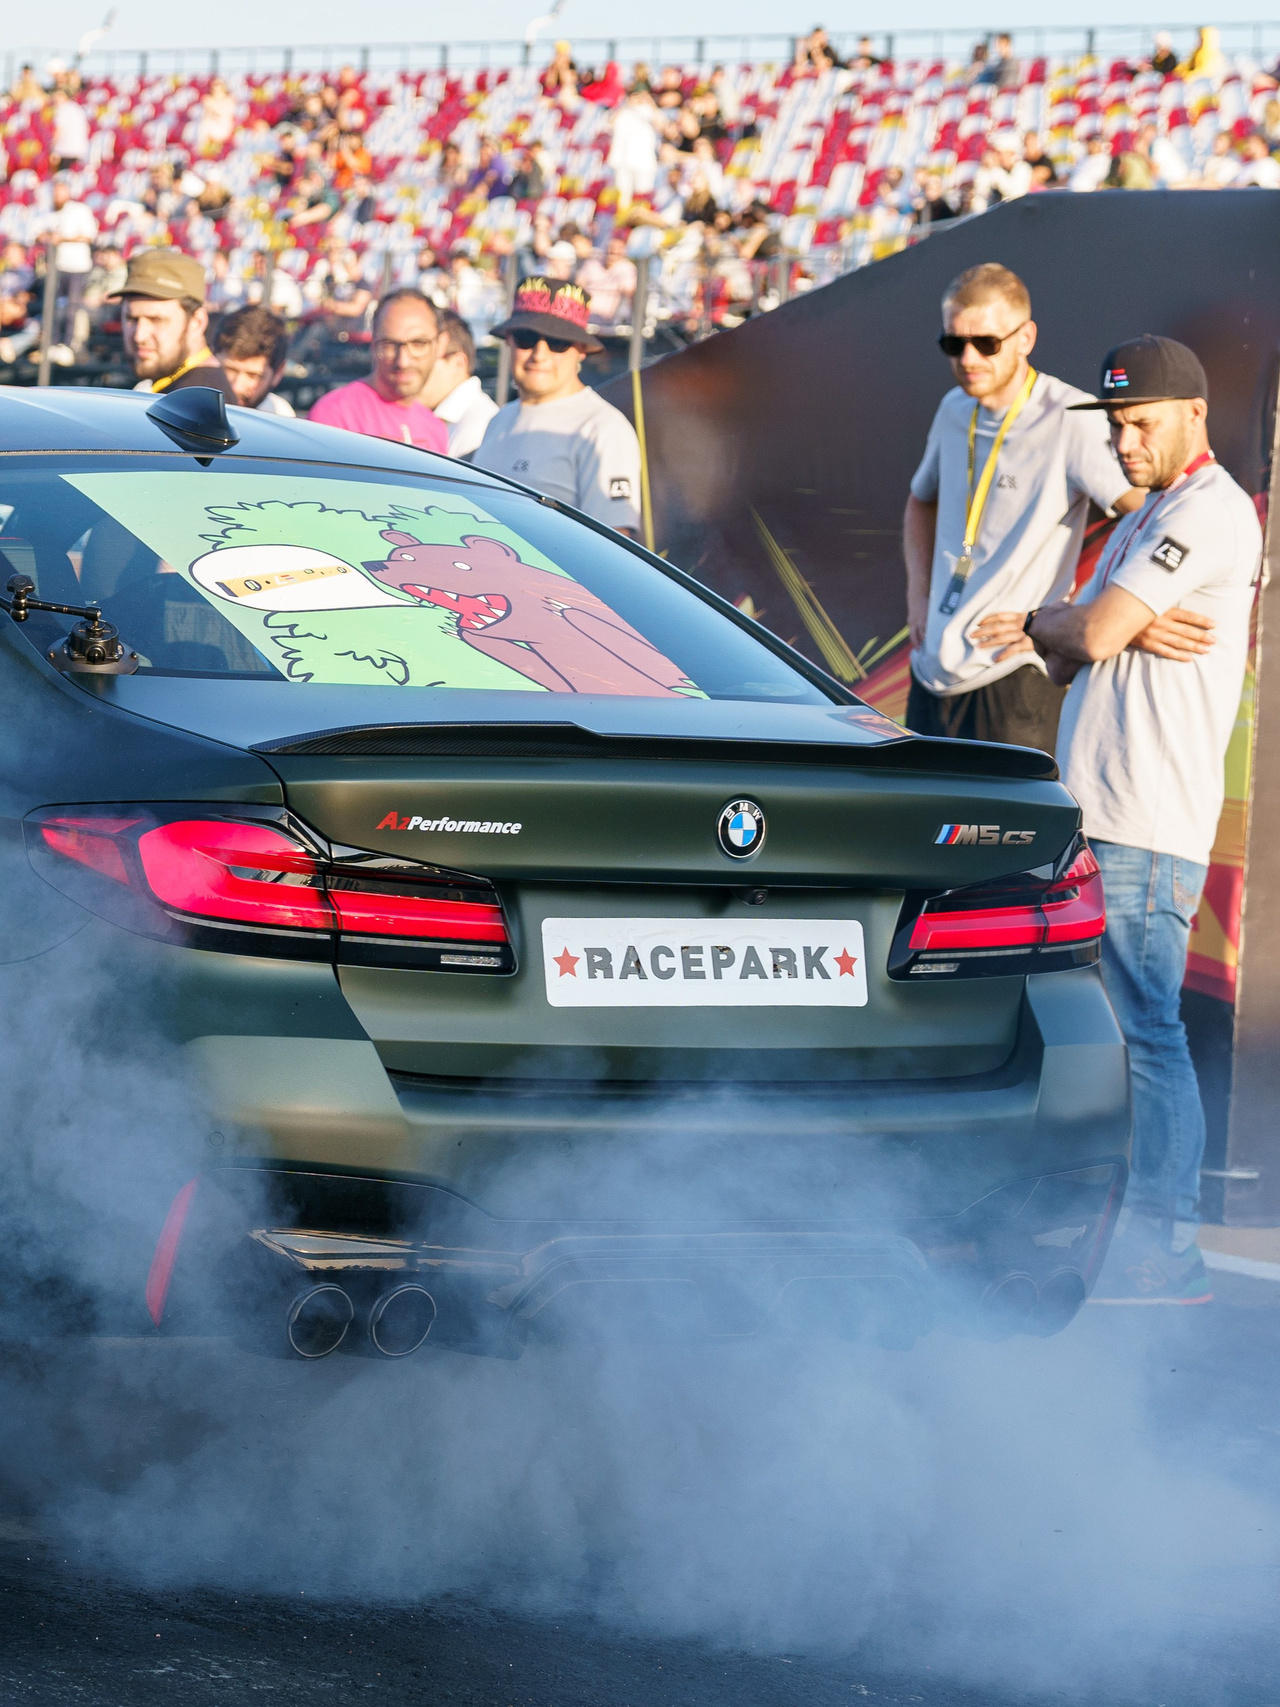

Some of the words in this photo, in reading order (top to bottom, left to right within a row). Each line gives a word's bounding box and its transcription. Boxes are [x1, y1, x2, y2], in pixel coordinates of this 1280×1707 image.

[724, 802, 762, 820] BMW
[954, 824, 1000, 845] M5
[1001, 830, 1037, 845] CS
[583, 945, 832, 980] RACEPARK
